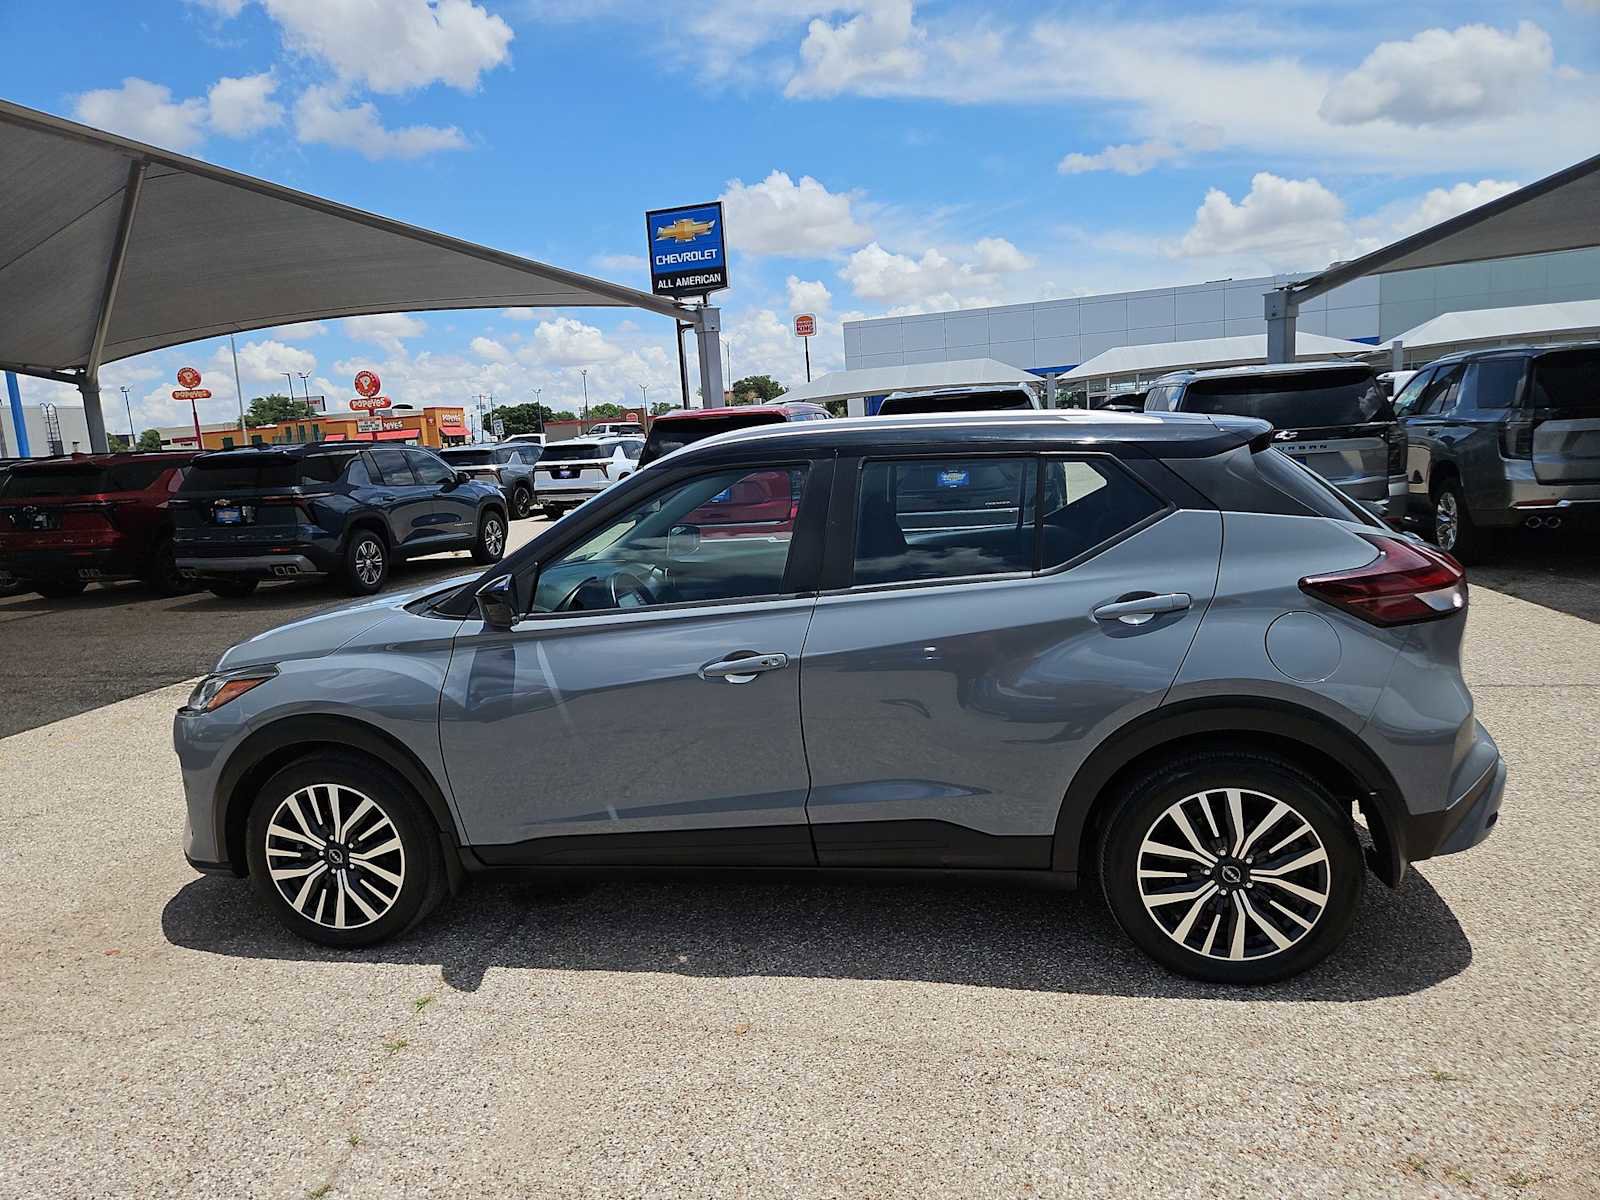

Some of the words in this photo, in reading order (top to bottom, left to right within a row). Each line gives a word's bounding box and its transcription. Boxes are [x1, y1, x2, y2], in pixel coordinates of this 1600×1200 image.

[656, 249, 717, 265] CHEVROLET
[658, 279, 674, 289] ALL
[676, 272, 721, 287] AMERICAN
[352, 398, 385, 408] POPEYES
